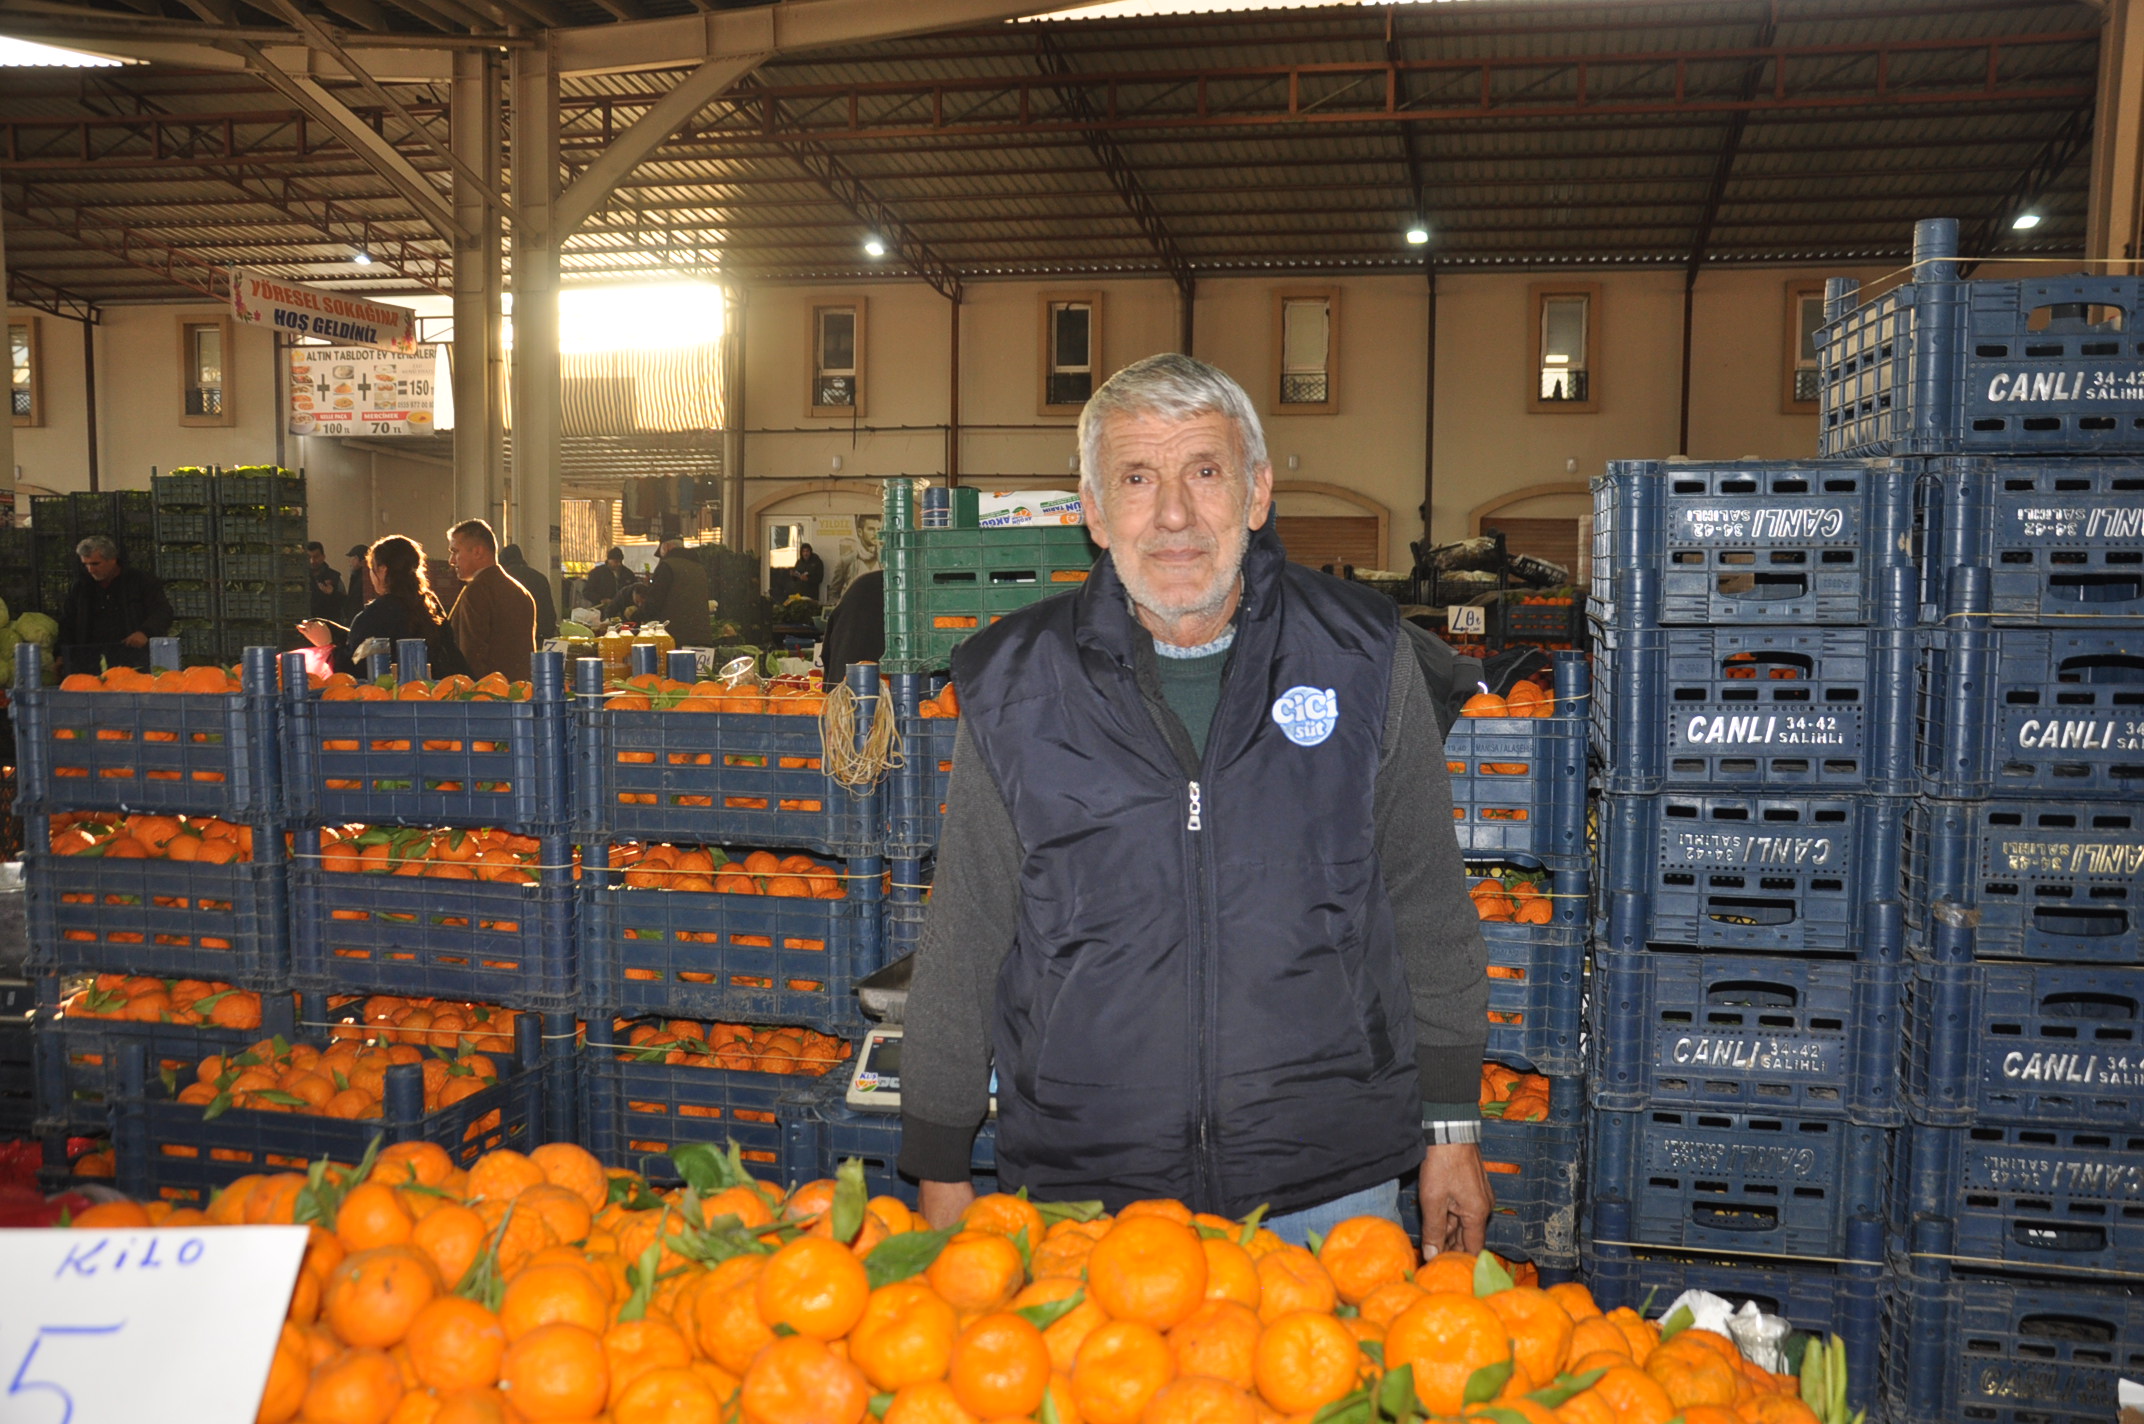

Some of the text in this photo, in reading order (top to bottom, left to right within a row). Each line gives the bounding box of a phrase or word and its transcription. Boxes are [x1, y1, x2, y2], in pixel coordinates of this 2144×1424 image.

[251, 278, 399, 327] YÖRESEL SOKAĞINA
[274, 308, 378, 344] HOŞ GELDİNİZ
[306, 351, 332, 361] ALTIN
[334, 350, 374, 361] TABLDOT
[410, 380, 429, 395] 150
[1987, 371, 2085, 402] CANLI
[323, 423, 342, 434] 100
[371, 422, 390, 434] 70
[1694, 523, 1744, 537] 34-42
[1751, 508, 1843, 538] CANLI
[2024, 522, 2077, 536] 34-42
[1295, 721, 1326, 738] süt
[1687, 716, 1776, 744] CANLI
[1787, 717, 1836, 730] 34-42
[2019, 720, 2115, 749] CANLI
[1685, 847, 1734, 861] 34-42
[1743, 836, 1832, 865] CANLI
[1673, 1037, 1761, 1068] CANLI
[1770, 1042, 1820, 1058] 34-42
[2003, 1051, 2097, 1083] CANLI
